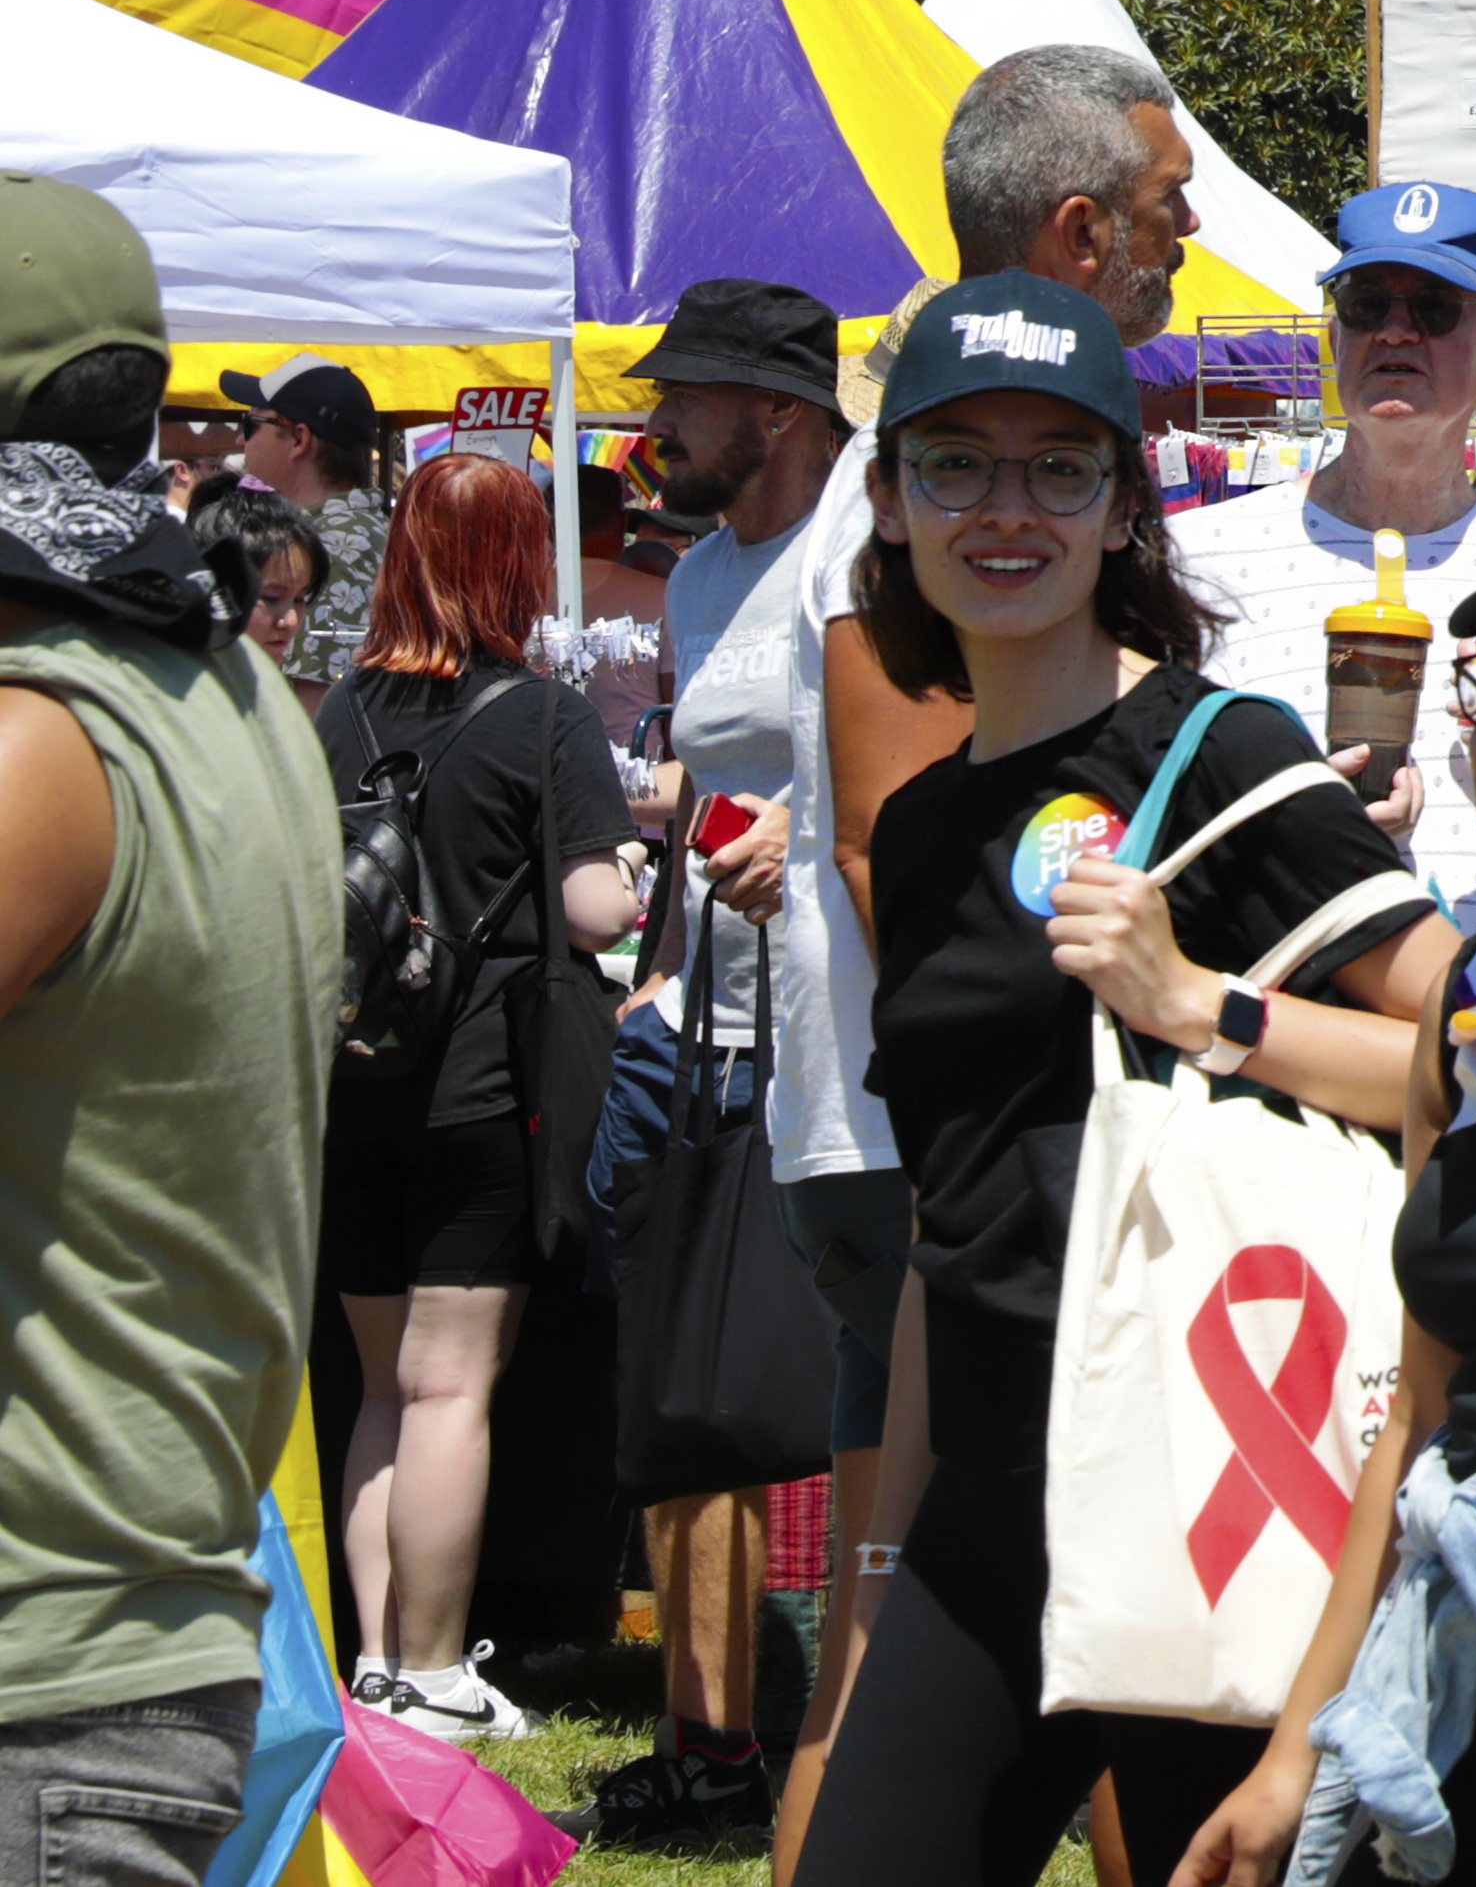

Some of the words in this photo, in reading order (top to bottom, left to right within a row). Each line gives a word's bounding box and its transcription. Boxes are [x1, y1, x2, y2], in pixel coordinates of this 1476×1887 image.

[457, 390, 543, 429] SALE
[1039, 813, 1108, 854] She
[1361, 1392, 1396, 1418] A
